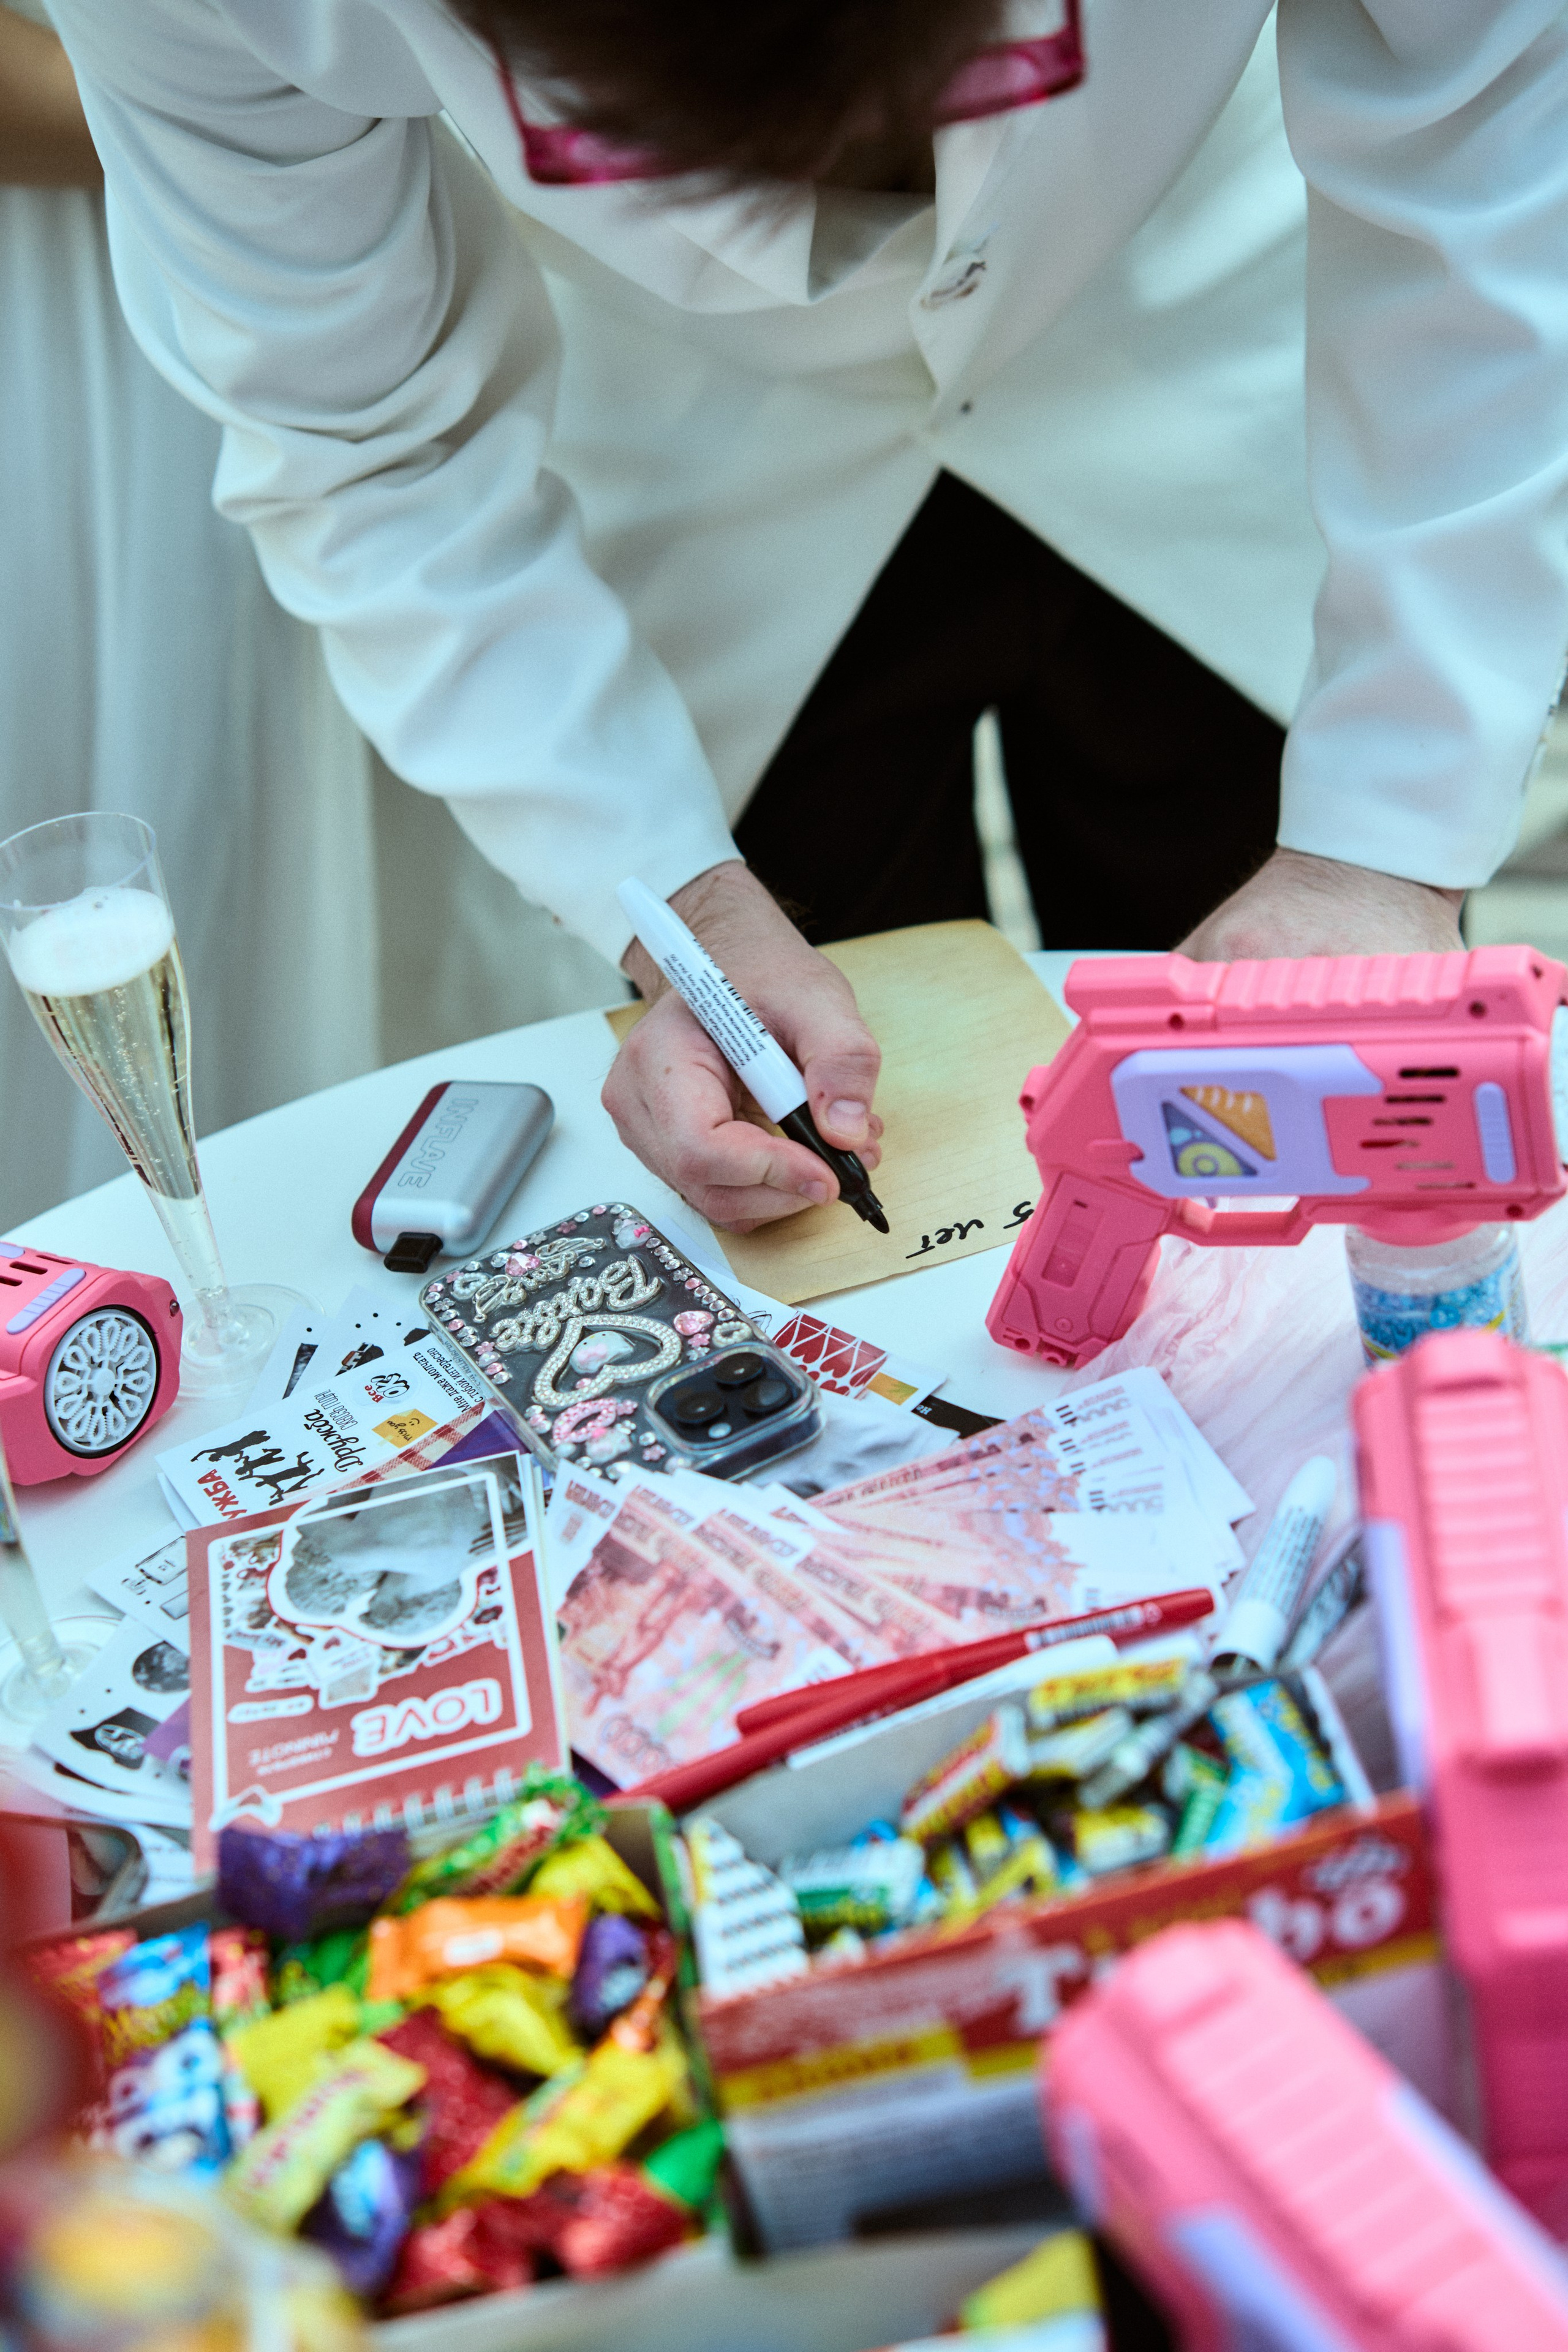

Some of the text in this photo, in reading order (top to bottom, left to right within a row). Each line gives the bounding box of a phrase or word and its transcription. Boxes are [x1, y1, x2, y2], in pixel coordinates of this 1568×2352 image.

[905, 1218, 984, 1259] лет
[488, 1254, 662, 1351] Barbie
[412, 1351, 441, 1379] молчать
[427, 1346, 461, 1379] интересно
[364, 1384, 383, 1402] Все
[436, 1378, 459, 1396] даже
[454, 1378, 478, 1398] тобой
[455, 1395, 471, 1412] Мне
[314, 1389, 357, 1430] СКВОЗЬ ГОДА!
[304, 1409, 366, 1472] Дружба
[397, 1429, 412, 1441] miss
[197, 1469, 247, 1519] УЖБА
[351, 1678, 502, 1757] LOVE
